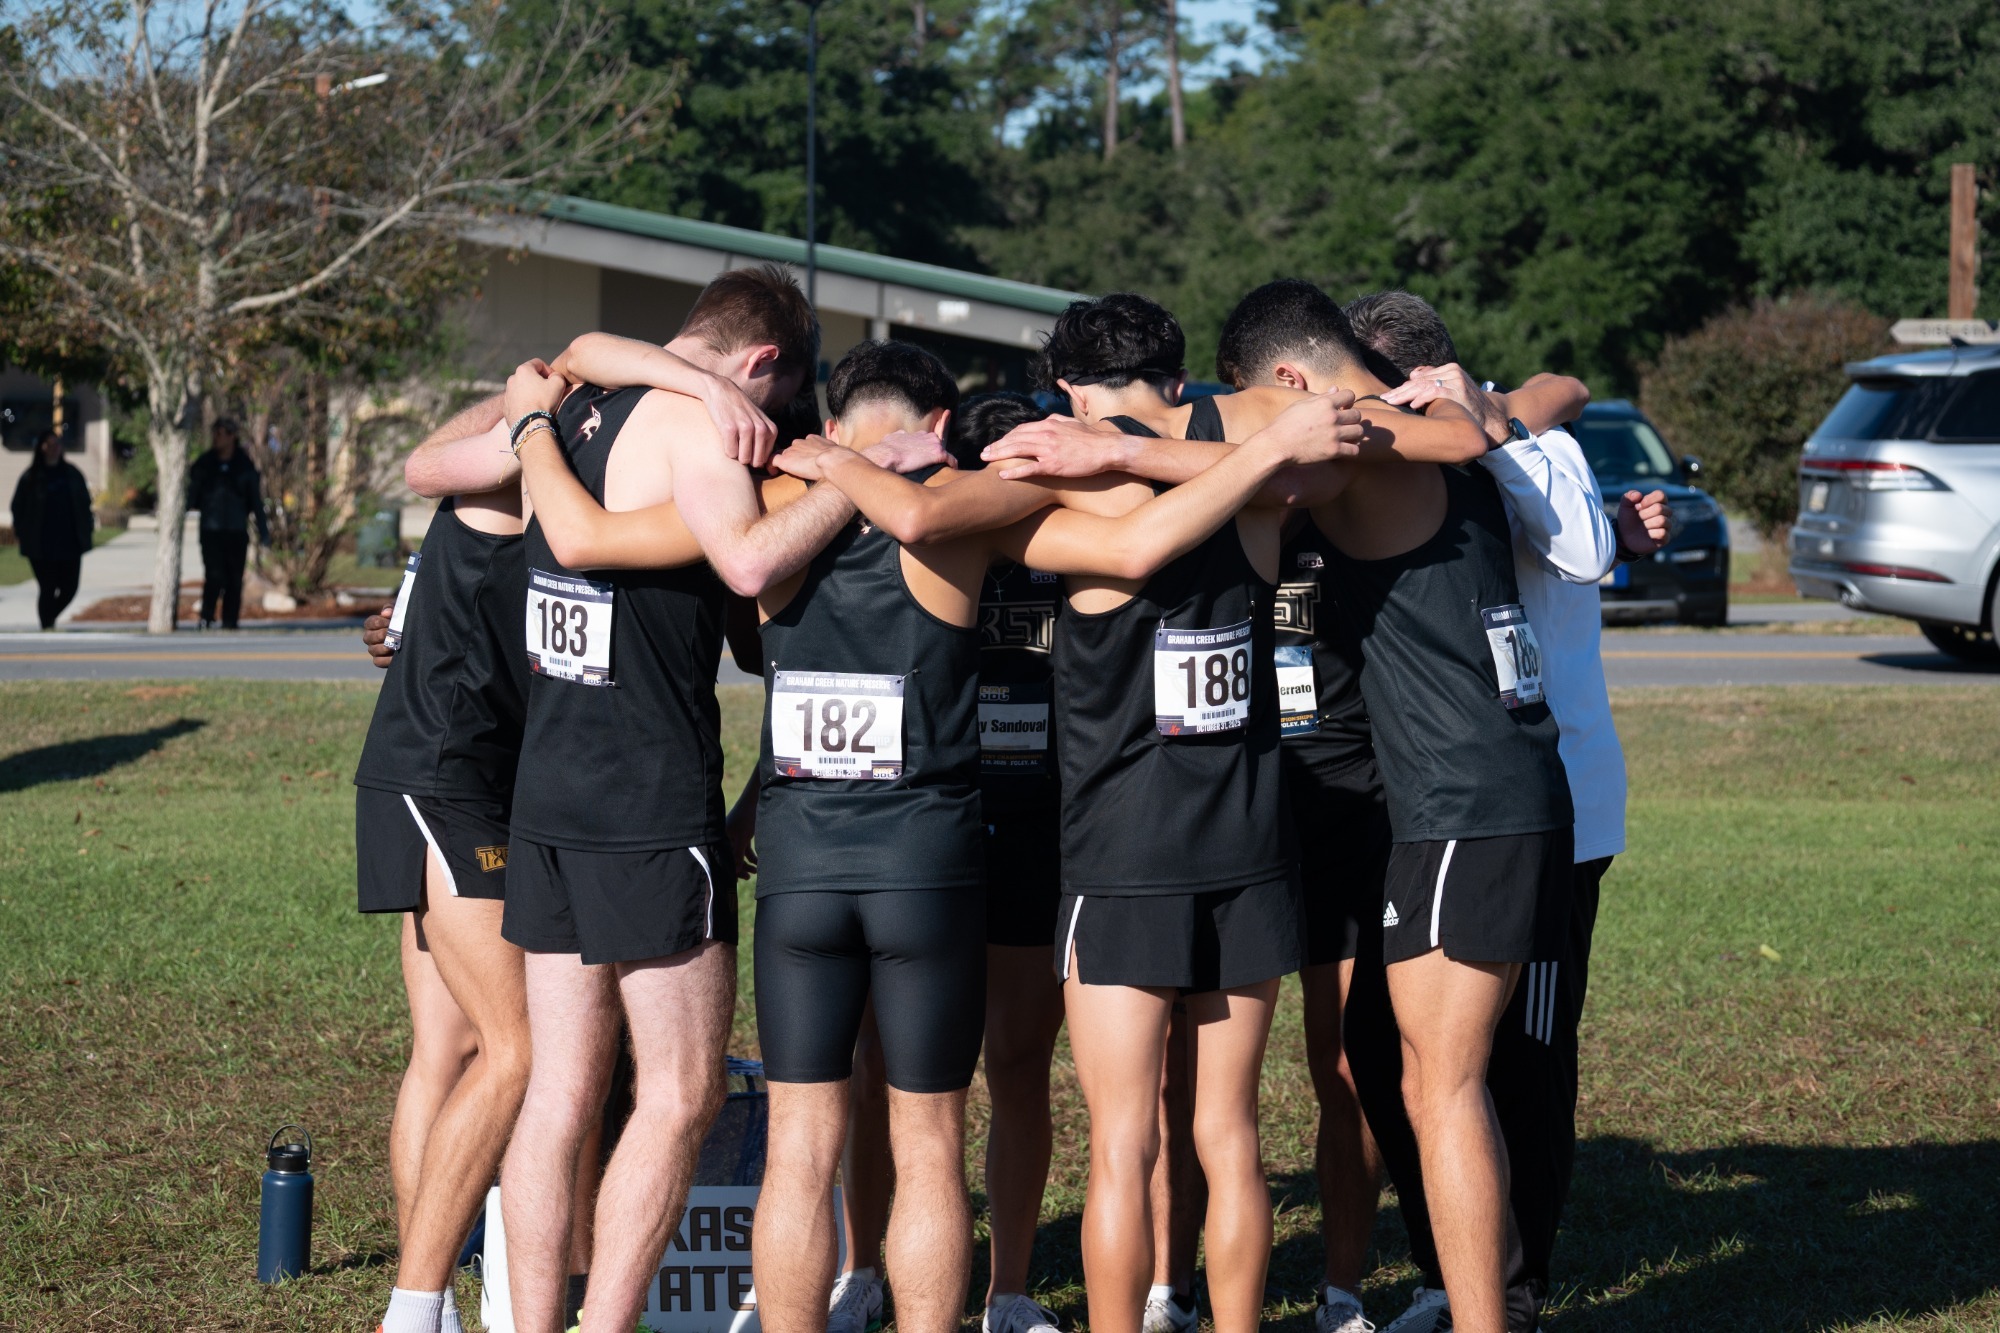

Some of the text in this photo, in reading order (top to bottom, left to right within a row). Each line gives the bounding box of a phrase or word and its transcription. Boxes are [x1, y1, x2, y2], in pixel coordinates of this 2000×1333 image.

[557, 581, 575, 594] NATURE
[537, 598, 588, 657] 183
[1167, 634, 1195, 645] GRAHAM
[1195, 634, 1216, 645] CREEK
[1216, 630, 1236, 643] NATURE
[786, 676, 891, 690] GRAHAM CREEK NATURE PRESERVE
[1178, 648, 1250, 709] 188
[979, 685, 1010, 701] SBC
[1280, 684, 1312, 696] errato
[796, 698, 877, 753] 182
[991, 719, 1046, 733] Sandoval
[1196, 722, 1220, 733] OCTOBER
[1300, 719, 1310, 727] AL
[872, 767, 895, 779] SBC
[642, 1265, 757, 1312] ATE
